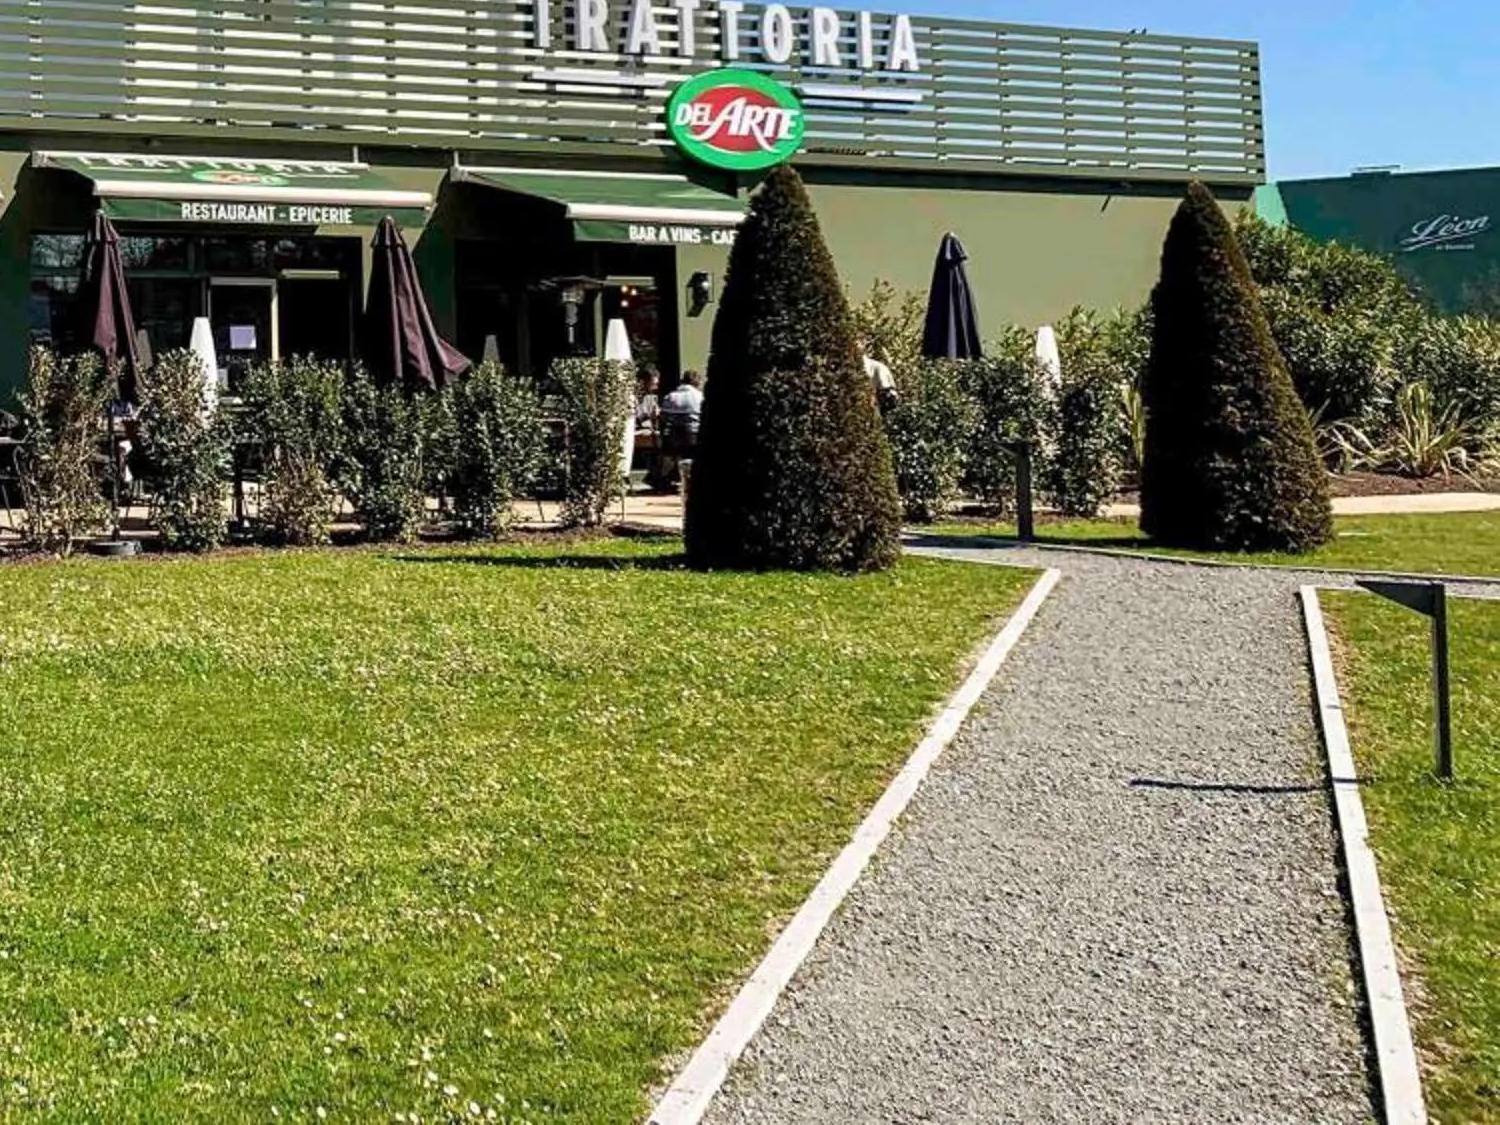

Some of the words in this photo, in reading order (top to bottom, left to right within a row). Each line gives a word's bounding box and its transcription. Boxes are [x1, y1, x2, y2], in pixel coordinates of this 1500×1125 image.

[674, 102, 713, 127] DEL
[685, 96, 800, 154] ARTE
[180, 202, 277, 224] RESTAURANT
[288, 206, 354, 225] EPICERIE
[629, 224, 657, 242] BAR
[669, 227, 701, 244] VINS
[711, 229, 739, 245] CAF
